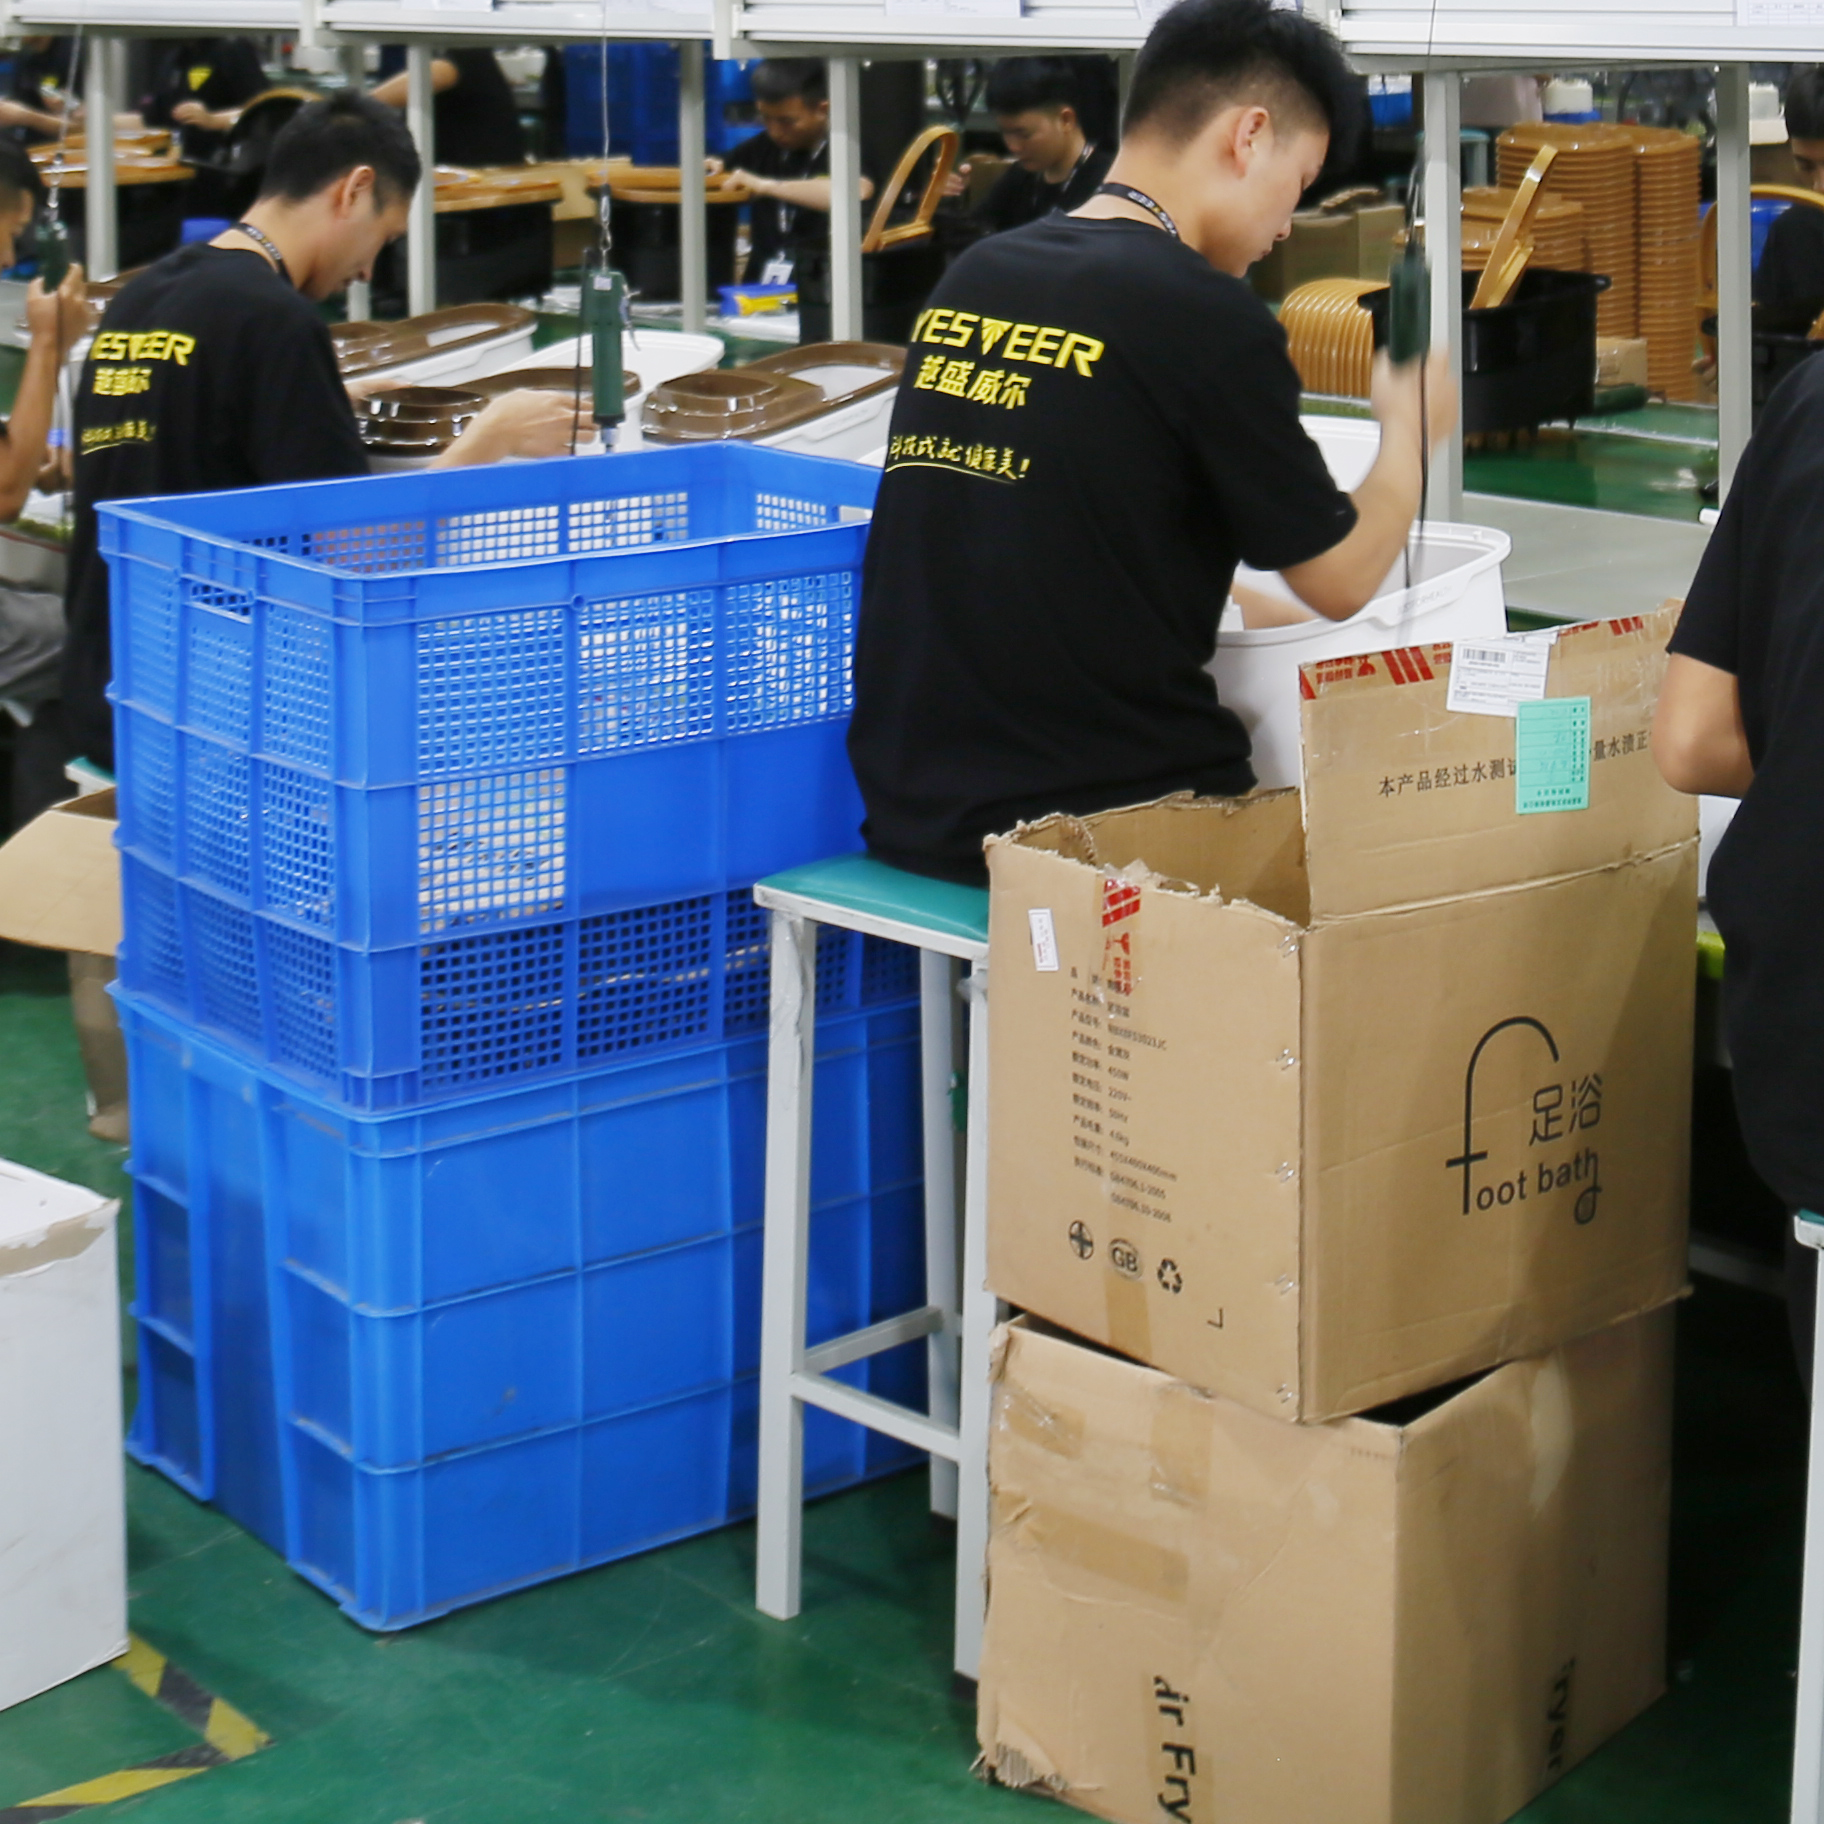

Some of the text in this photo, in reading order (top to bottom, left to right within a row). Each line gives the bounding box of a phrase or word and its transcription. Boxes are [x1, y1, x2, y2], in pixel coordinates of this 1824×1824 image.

[913, 354, 1032, 410] 越盛威尔
[1529, 1073, 1603, 1147] 足浴
